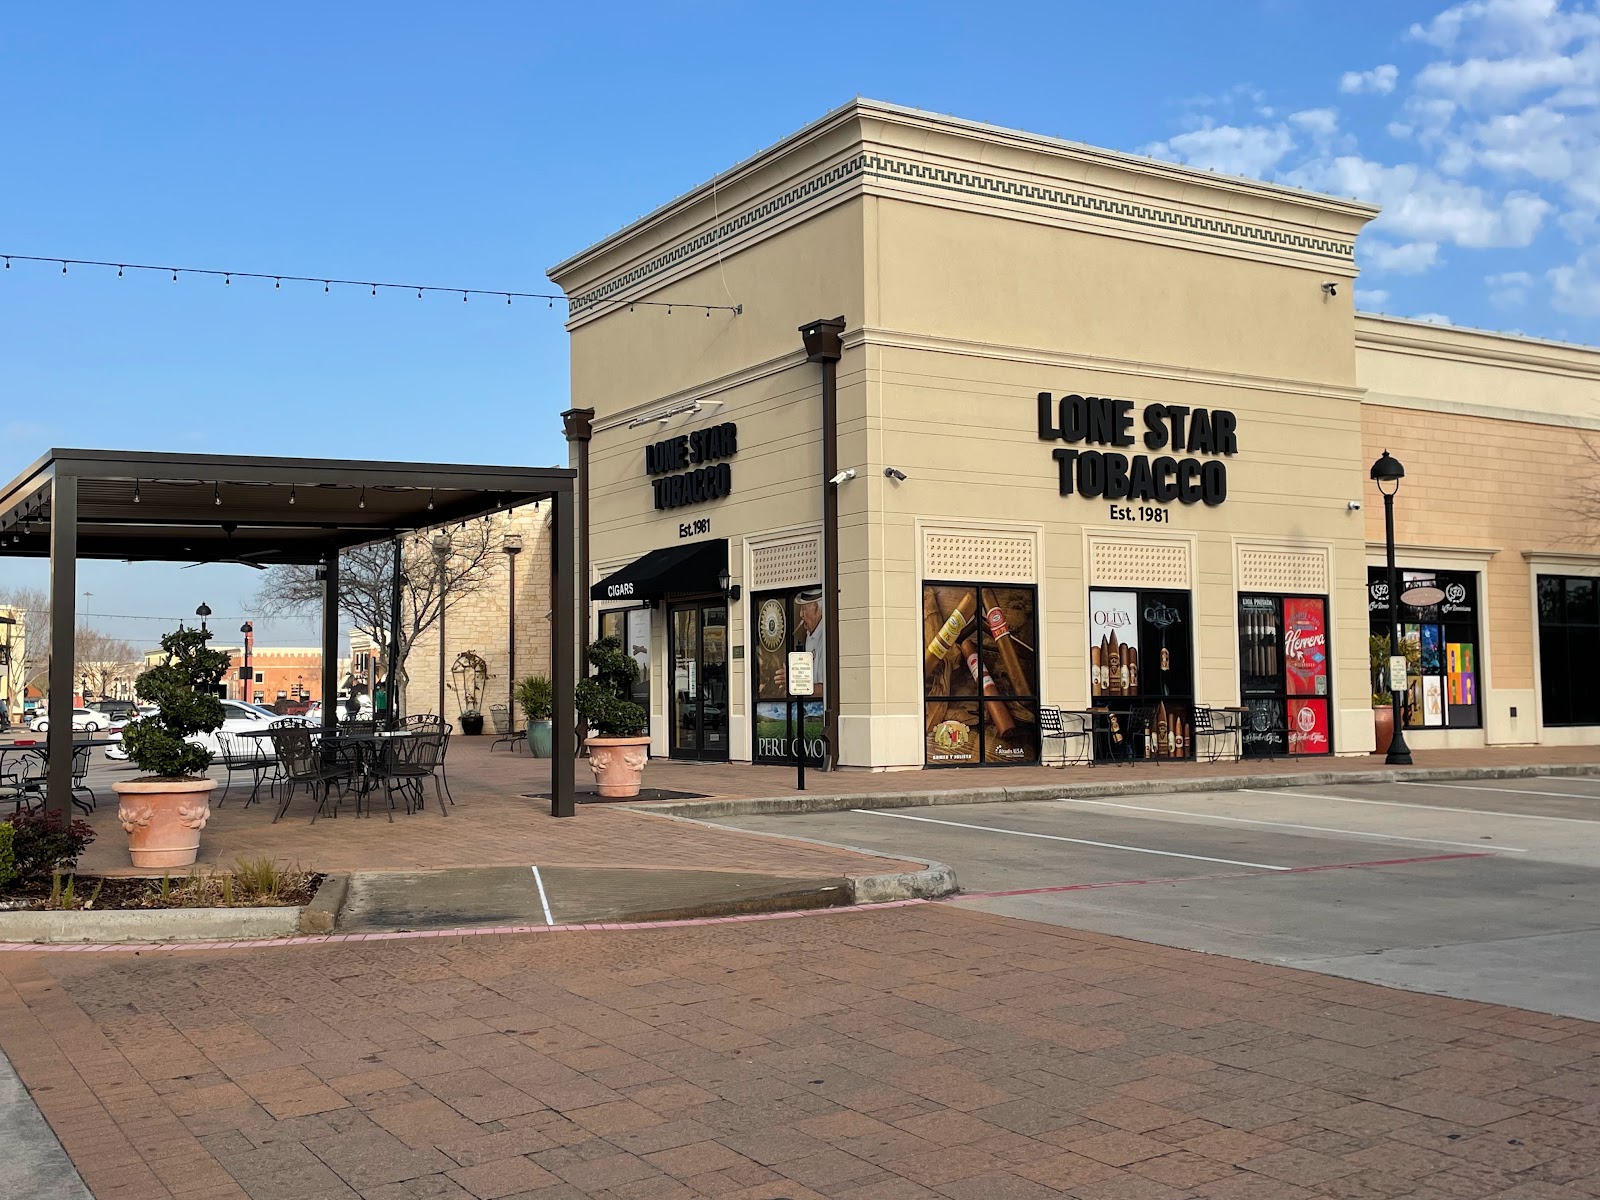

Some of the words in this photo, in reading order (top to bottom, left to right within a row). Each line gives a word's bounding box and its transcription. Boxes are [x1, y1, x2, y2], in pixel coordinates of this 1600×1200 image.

[1038, 392, 1135, 446] LONE
[1143, 403, 1238, 455] STAR
[646, 434, 688, 475] LONE
[689, 422, 737, 464] STAR
[652, 463, 731, 510] TOBACCO
[1052, 448, 1227, 505] TOBACCO
[1110, 504, 1136, 521] Est.
[1138, 506, 1169, 523] 1981
[607, 583, 634, 597] CIGARS
[1094, 609, 1132, 627] OLIVA
[1285, 629, 1325, 657] Herrera
